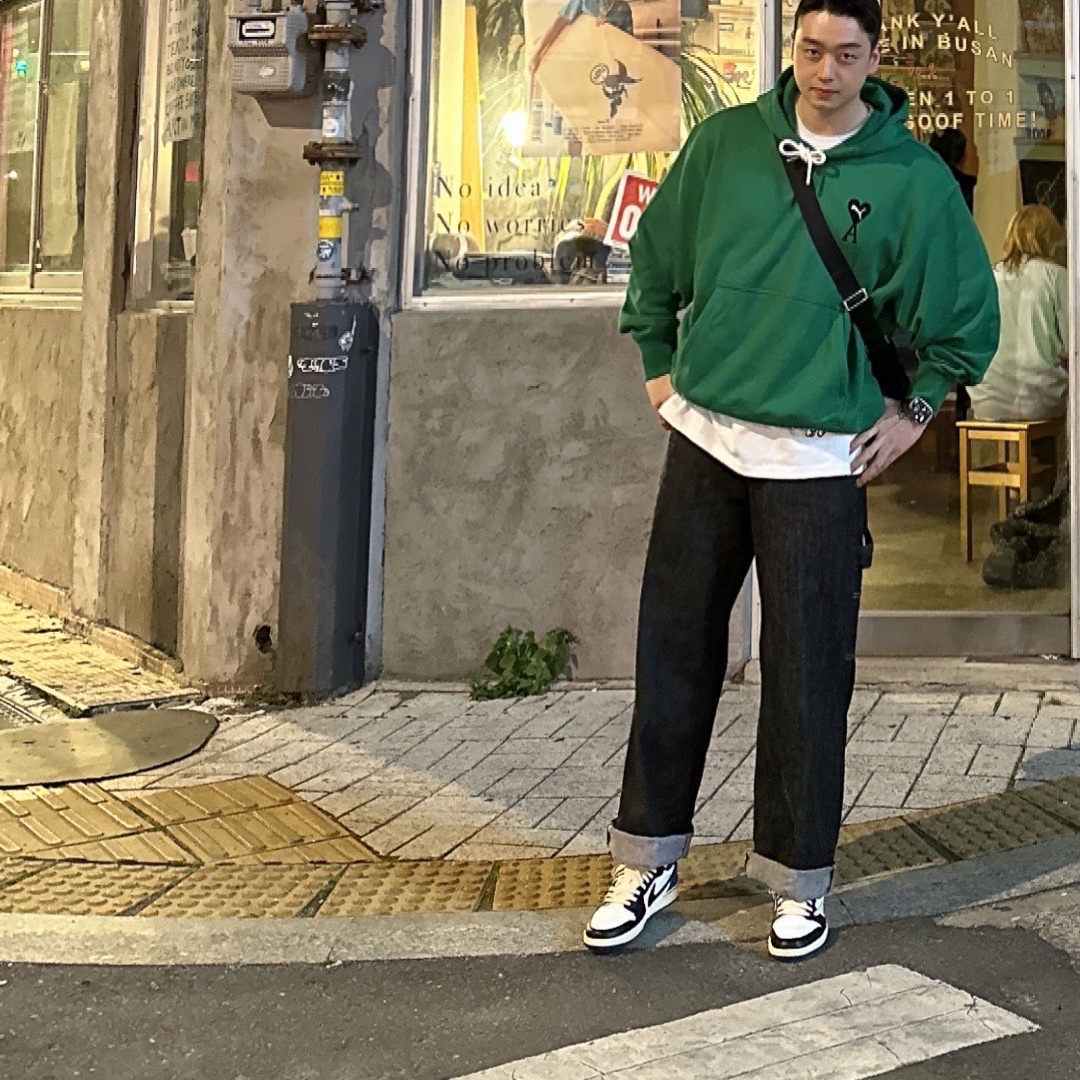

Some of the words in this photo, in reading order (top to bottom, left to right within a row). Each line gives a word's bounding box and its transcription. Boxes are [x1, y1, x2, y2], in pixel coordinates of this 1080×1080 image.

[932, 13, 998, 41] Y'ALL
[902, 34, 924, 50] IN
[937, 35, 1013, 68] BUSAN
[944, 90, 954, 106] 1
[966, 90, 994, 105] TO
[1006, 90, 1014, 105] 1
[975, 110, 1037, 129] TIME!
[438, 175, 472, 199] No
[488, 175, 541, 198] idea
[437, 212, 470, 234] No
[486, 212, 585, 234] worries
